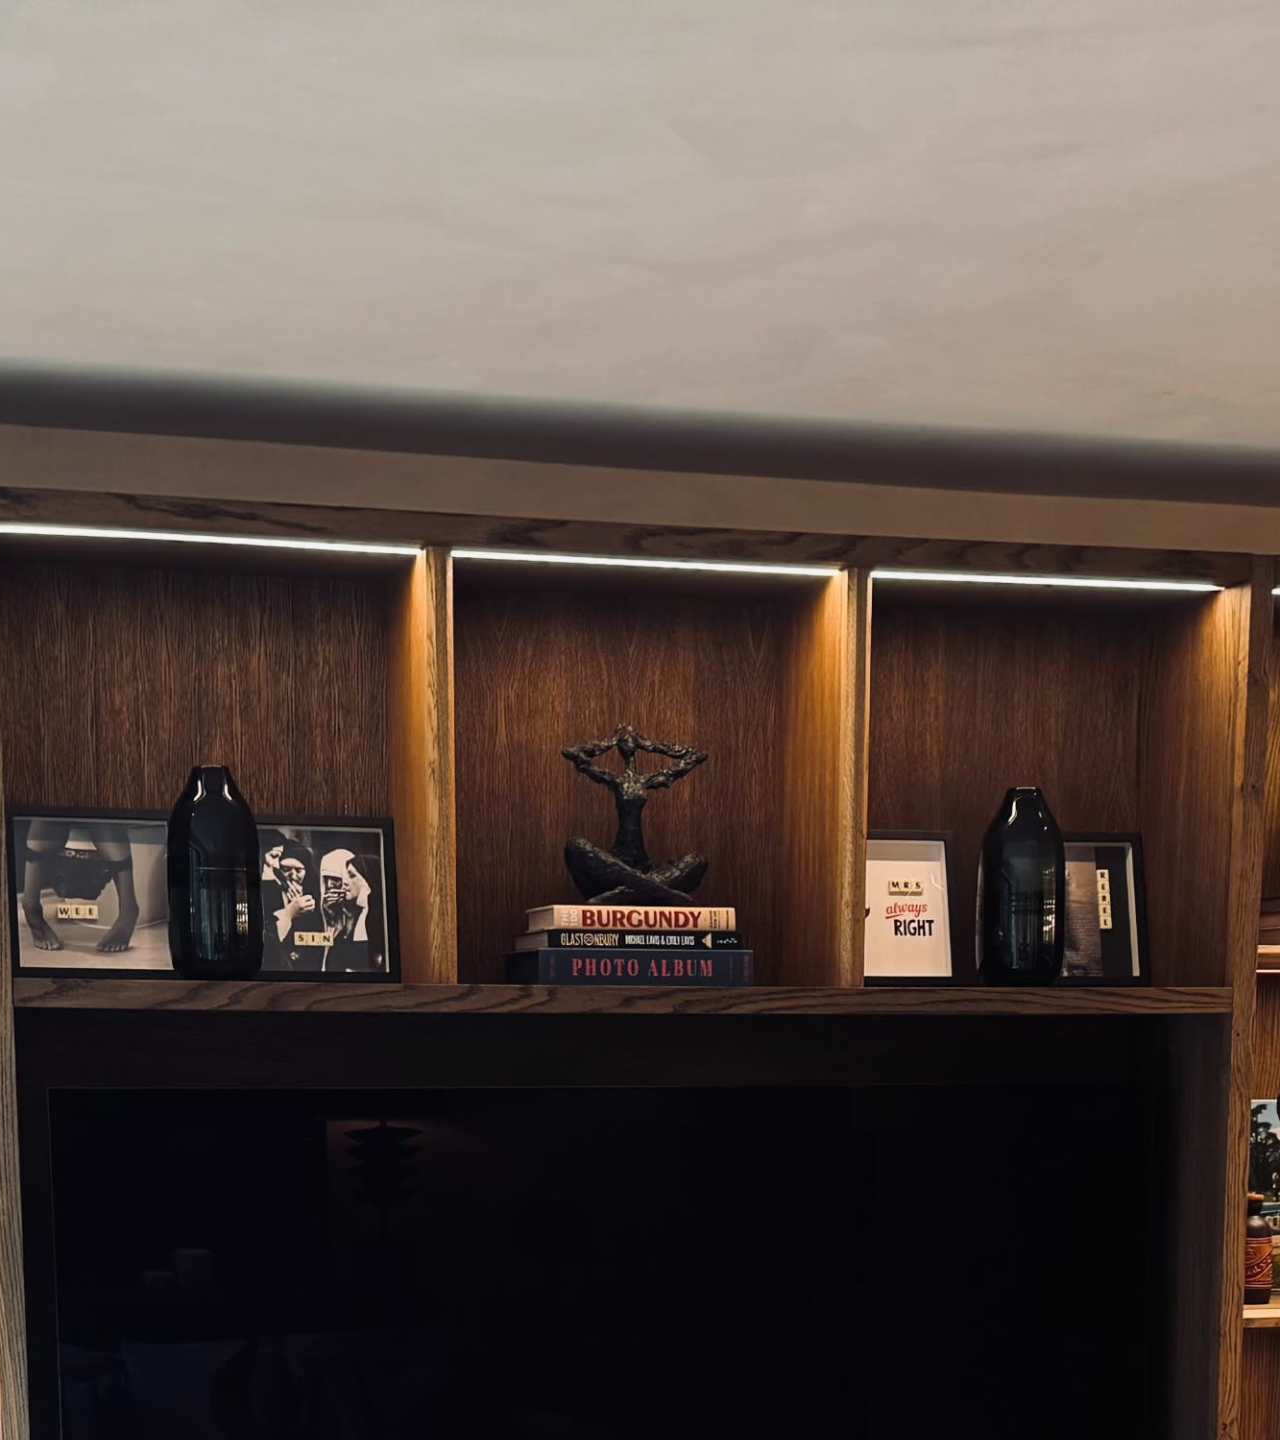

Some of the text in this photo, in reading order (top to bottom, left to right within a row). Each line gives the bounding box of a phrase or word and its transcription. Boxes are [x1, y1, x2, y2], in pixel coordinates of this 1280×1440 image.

[582, 910, 702, 929] BURGUNDY
[885, 902, 928, 919] always
[894, 919, 935, 937] RIGHT
[297, 934, 331, 944] SIN
[571, 958, 713, 977] PHOTO ALBUM
